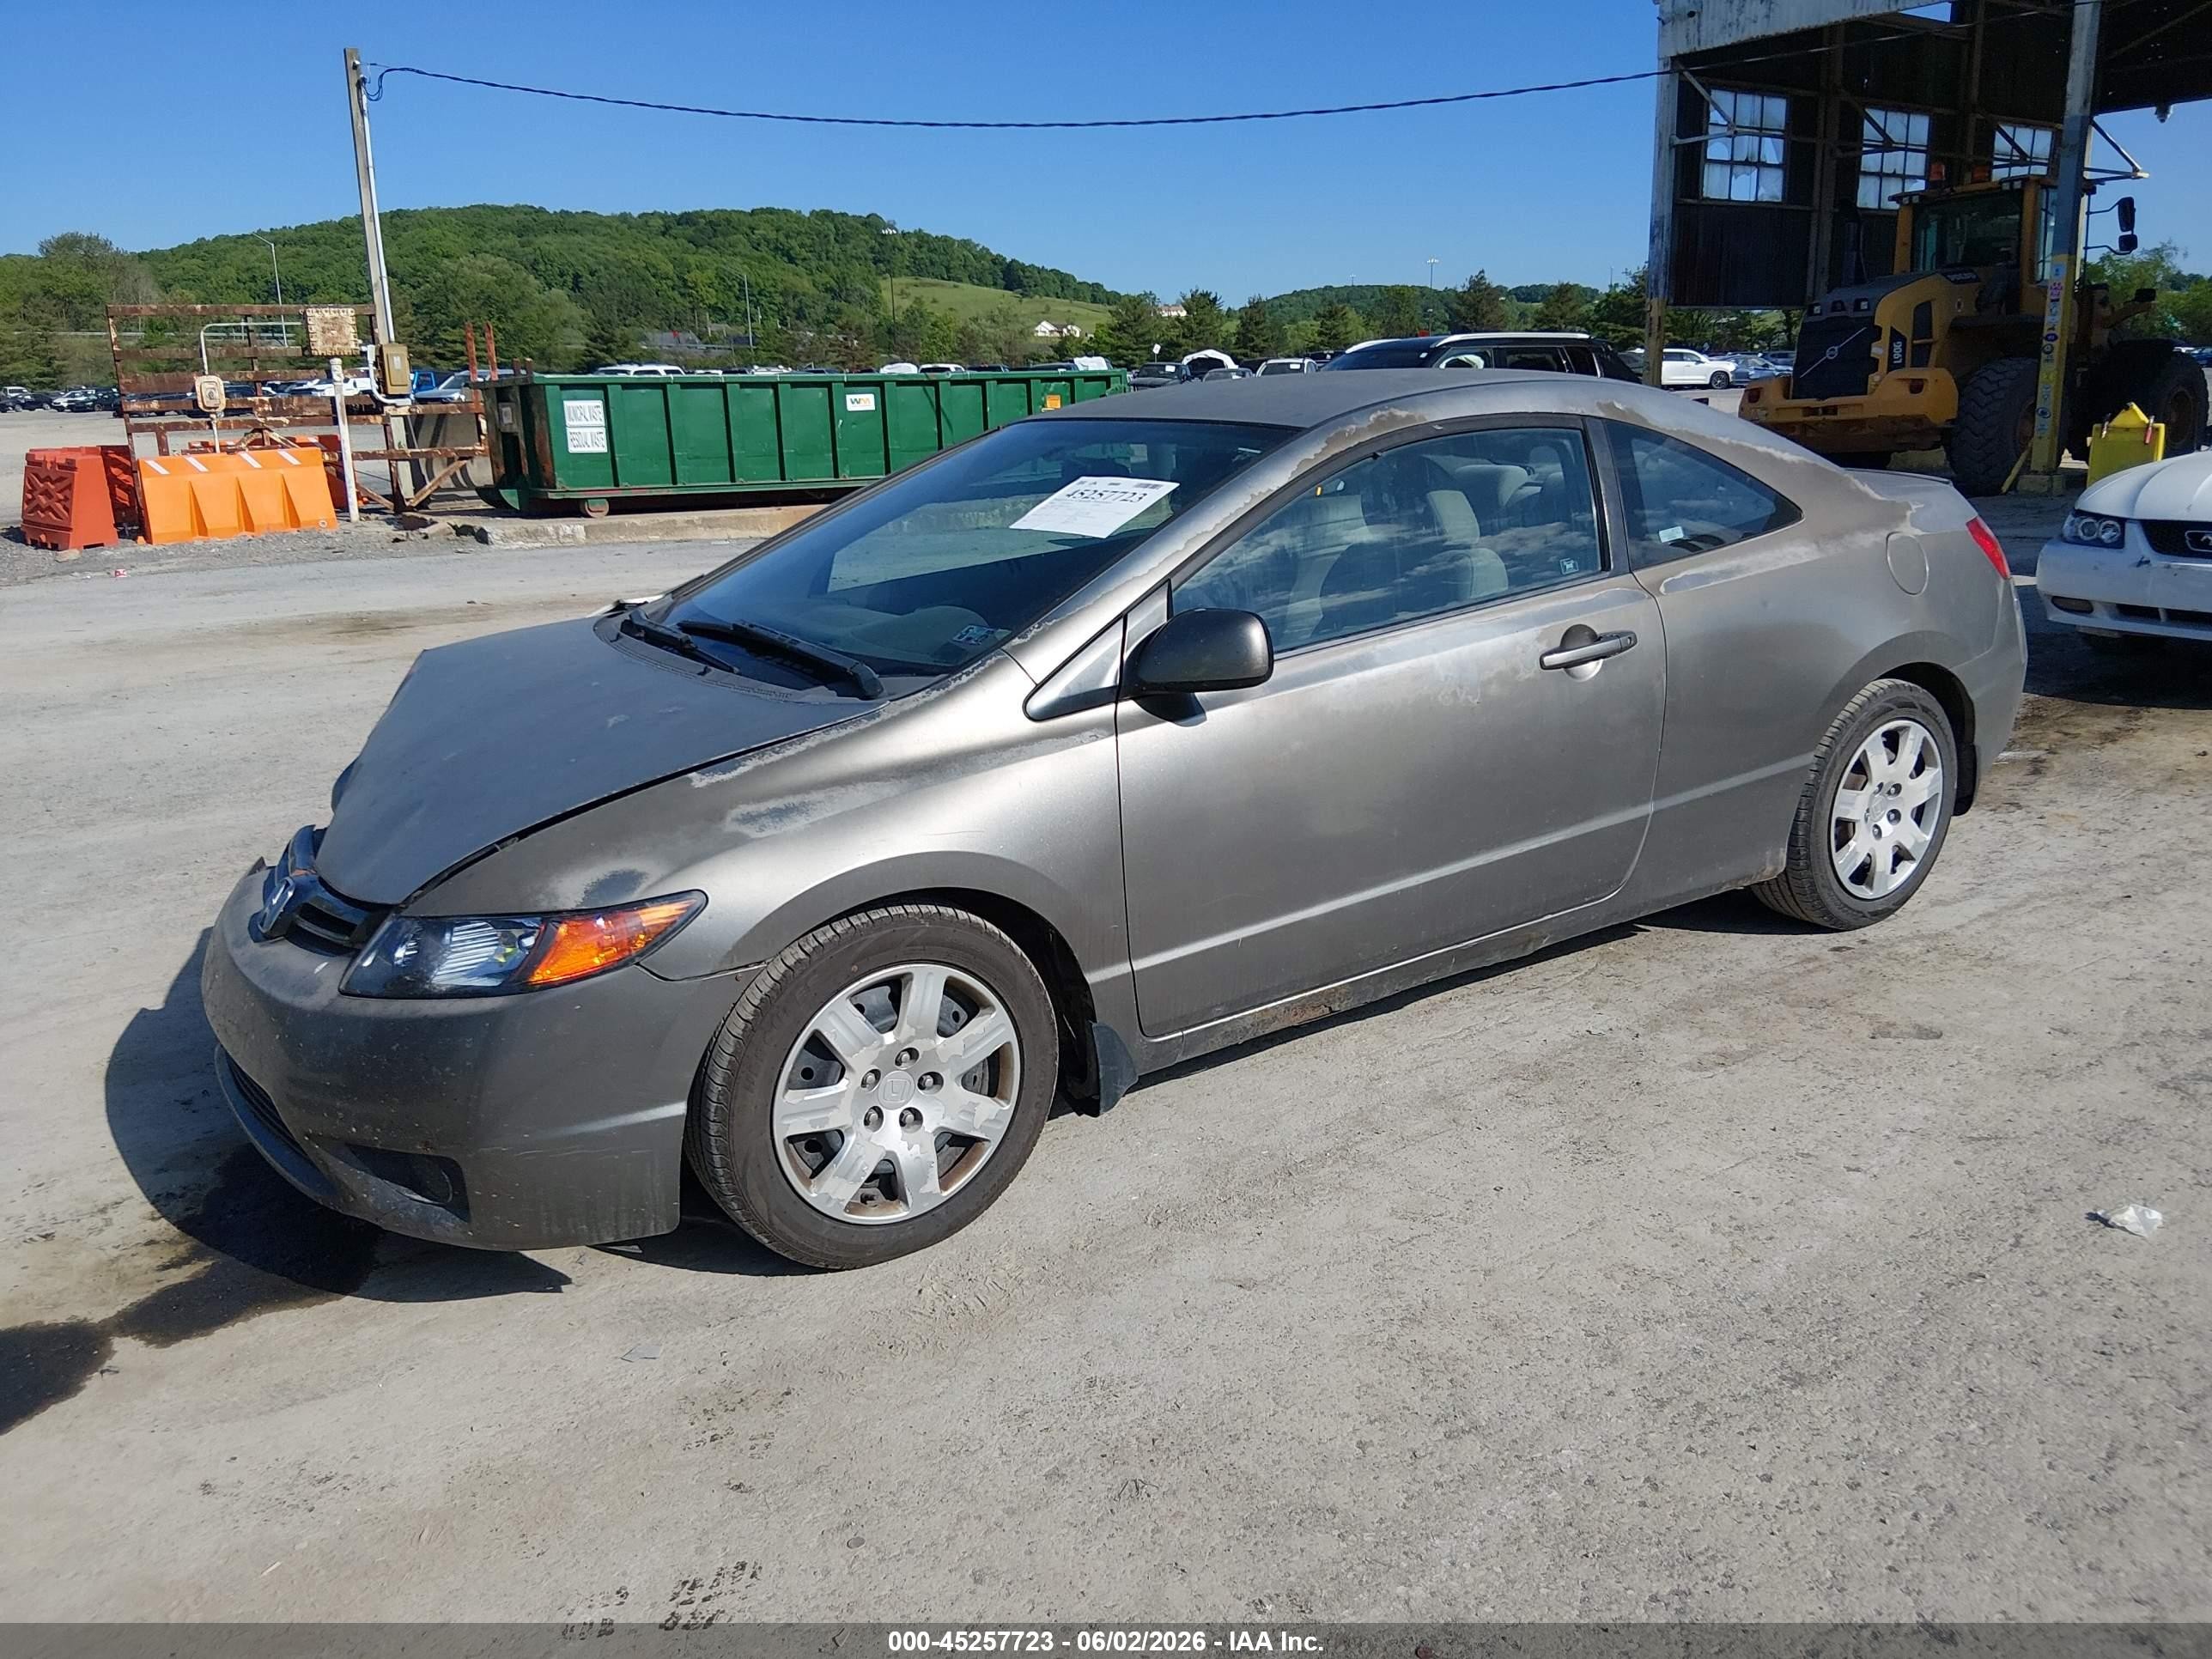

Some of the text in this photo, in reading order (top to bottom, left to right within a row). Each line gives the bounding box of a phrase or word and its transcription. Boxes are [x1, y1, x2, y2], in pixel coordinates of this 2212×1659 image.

[1893, 341, 1903, 364] L90G
[567, 404, 603, 422] MUNICIPAL WASTE
[569, 432, 605, 447] RESIDUAL WASTE
[1066, 489, 1147, 503] 45257723
